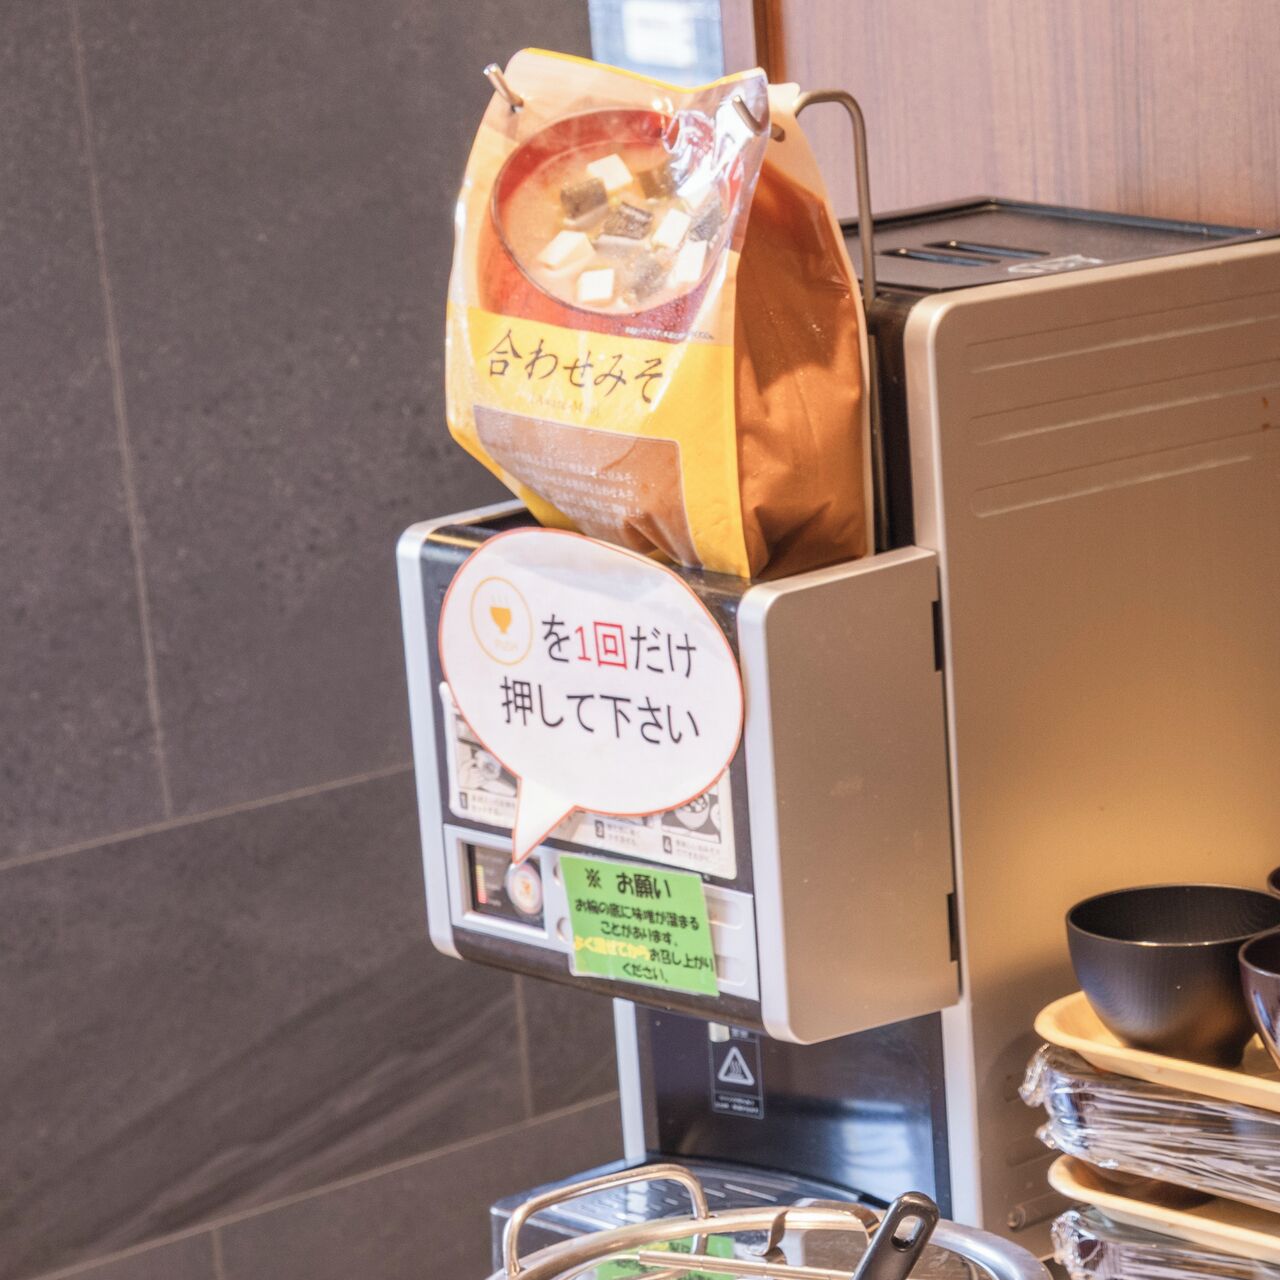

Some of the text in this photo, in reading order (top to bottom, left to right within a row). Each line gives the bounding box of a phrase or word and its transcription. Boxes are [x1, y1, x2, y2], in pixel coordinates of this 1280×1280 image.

[488, 328, 666, 404] 合わせみそ
[541, 613, 698, 679] を1回だけ
[499, 676, 701, 746] 押して下さい
[616, 871, 672, 899] お願い
